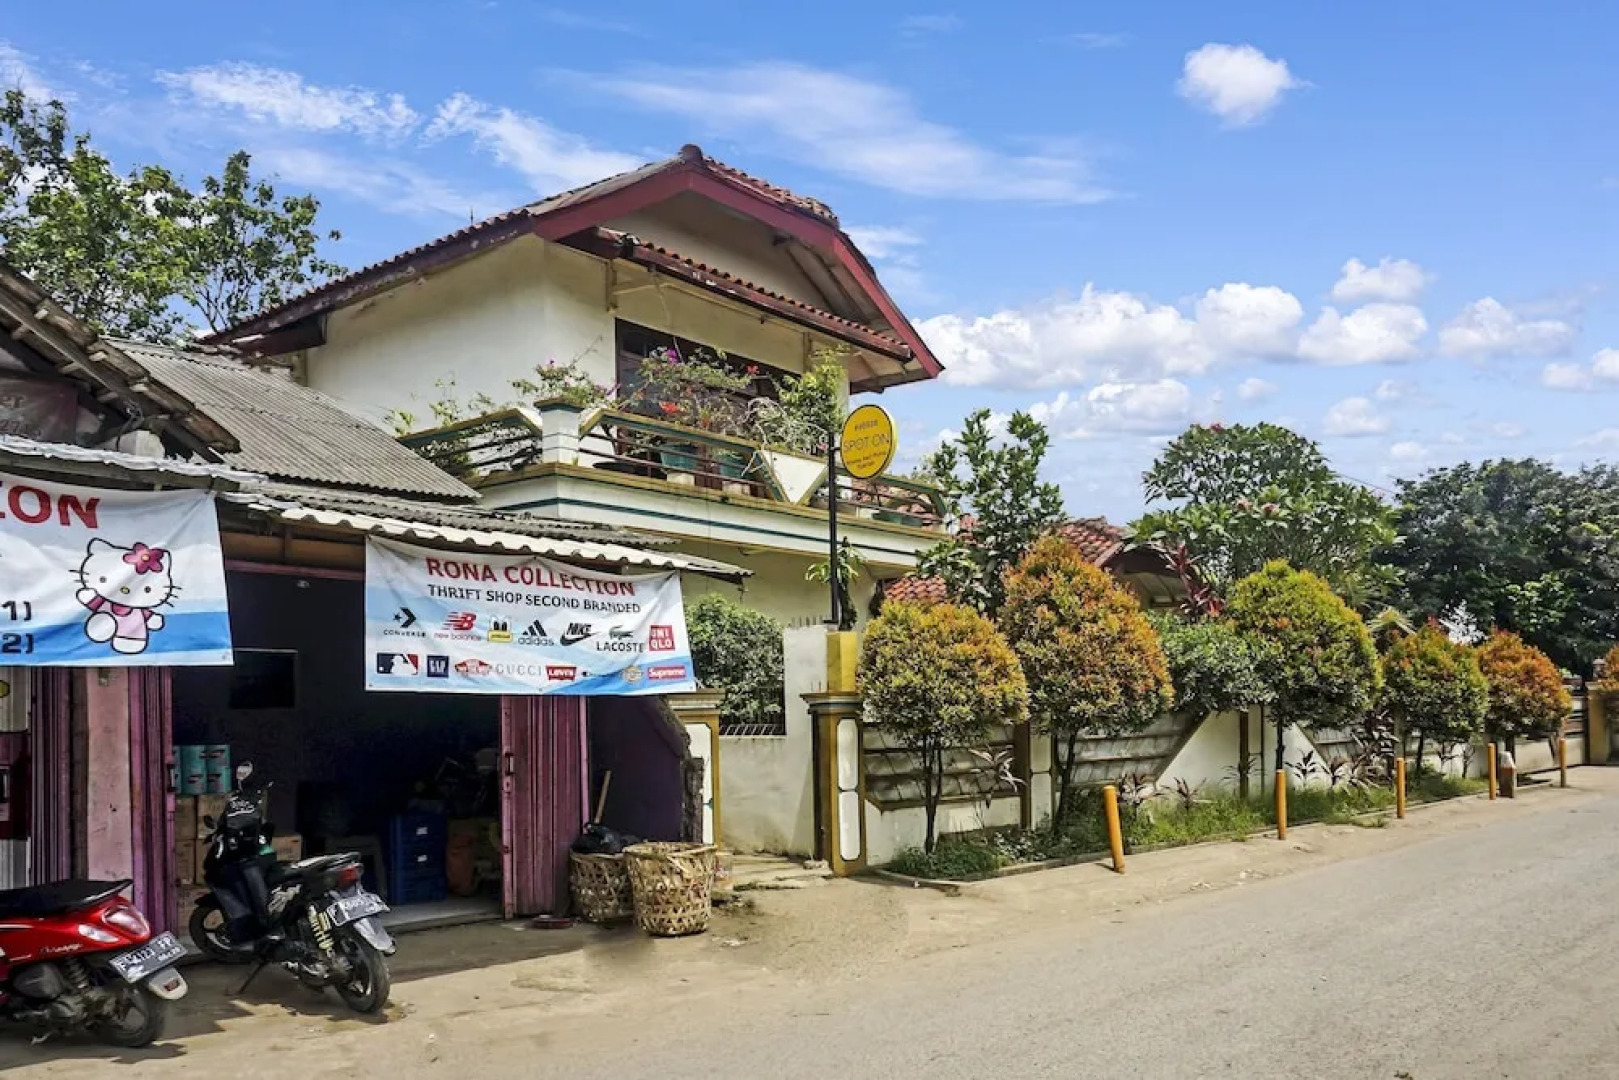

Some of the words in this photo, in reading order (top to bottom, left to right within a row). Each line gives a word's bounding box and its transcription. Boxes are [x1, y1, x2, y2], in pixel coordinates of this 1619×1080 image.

[0, 481, 100, 529] ON
[425, 557, 498, 583] RONA
[504, 565, 636, 598] COLLECTION
[427, 584, 482, 600] THRIFT
[486, 590, 523, 605] SHOP
[525, 594, 580, 610] SECOND
[583, 599, 641, 614] BRANDED
[566, 622, 593, 636] NIKE
[517, 637, 555, 647] adidas
[596, 641, 646, 653] LACOSTE
[495, 664, 542, 676] GUCCI
